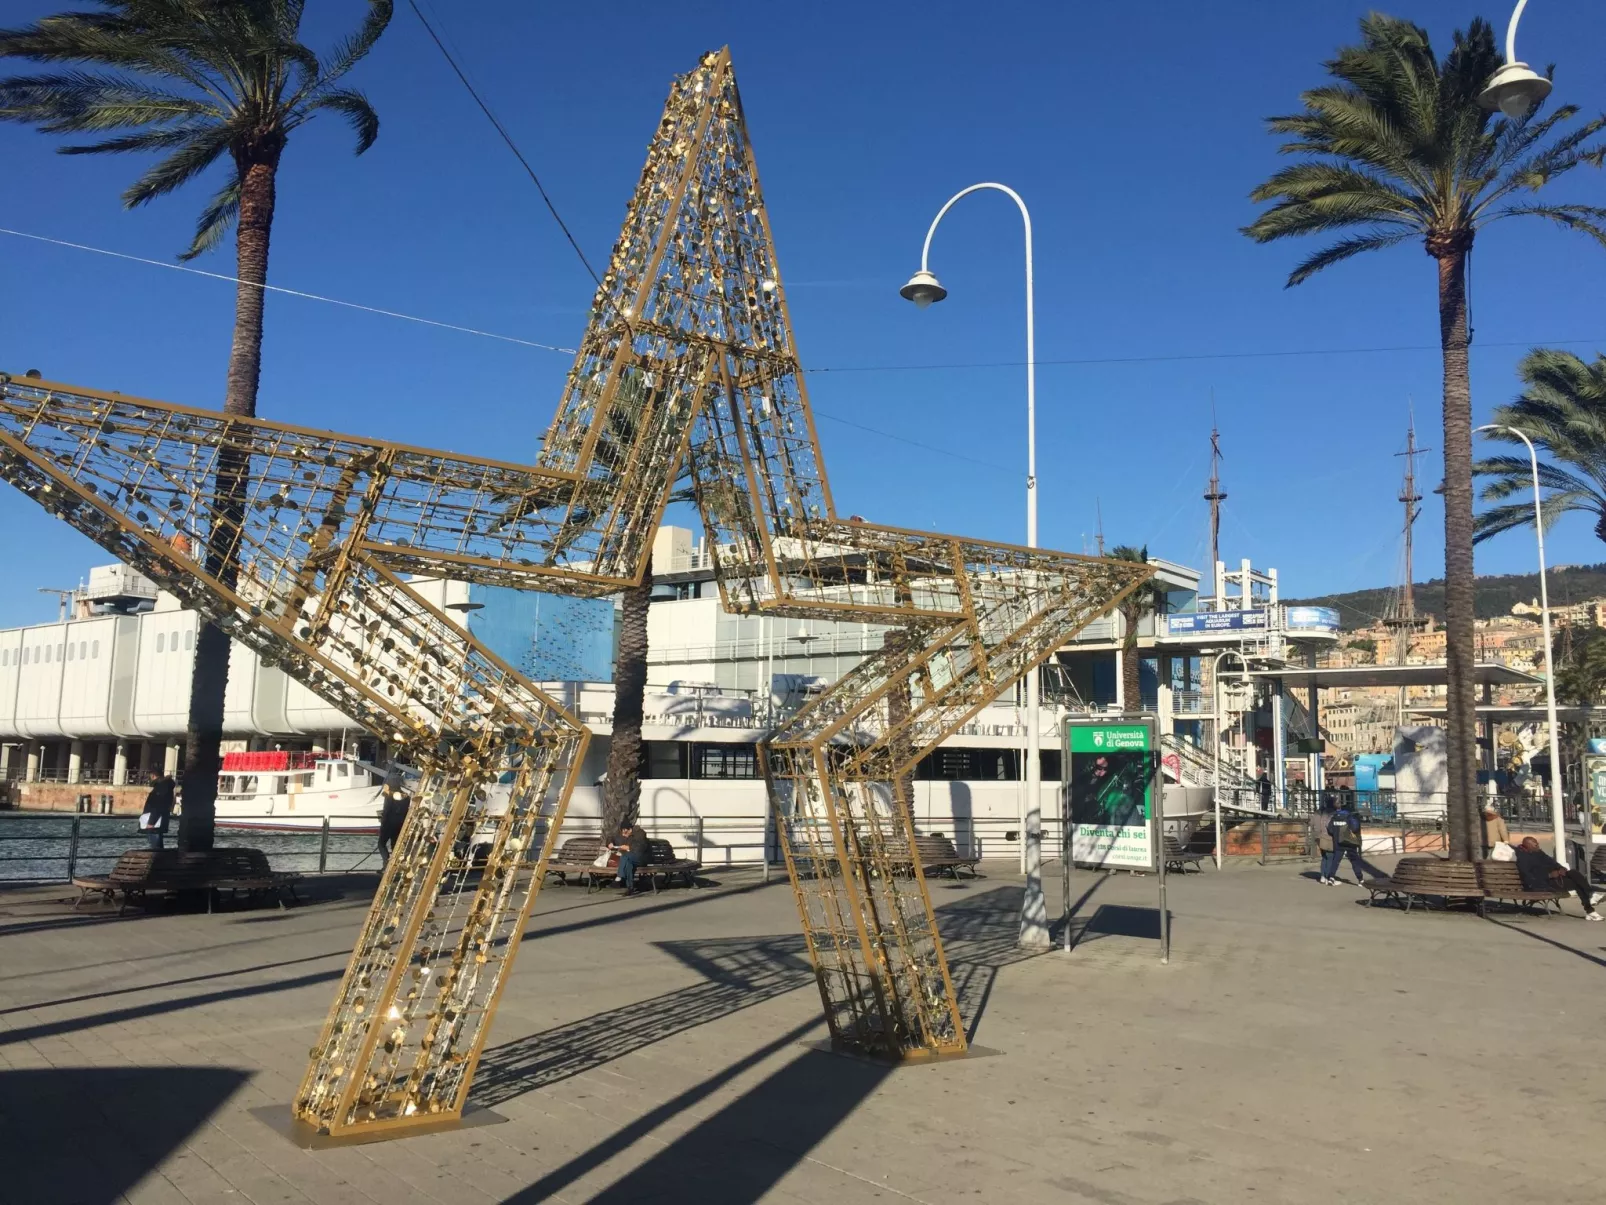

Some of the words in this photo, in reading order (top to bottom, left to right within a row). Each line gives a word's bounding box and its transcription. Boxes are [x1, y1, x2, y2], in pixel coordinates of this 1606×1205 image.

[1106, 731, 1144, 739] Università
[1106, 739, 1114, 747] di
[1114, 739, 1144, 747] Genova
[1080, 827, 1114, 838] Diventa
[1116, 829, 1131, 839] chi
[1133, 829, 1147, 840] sei
